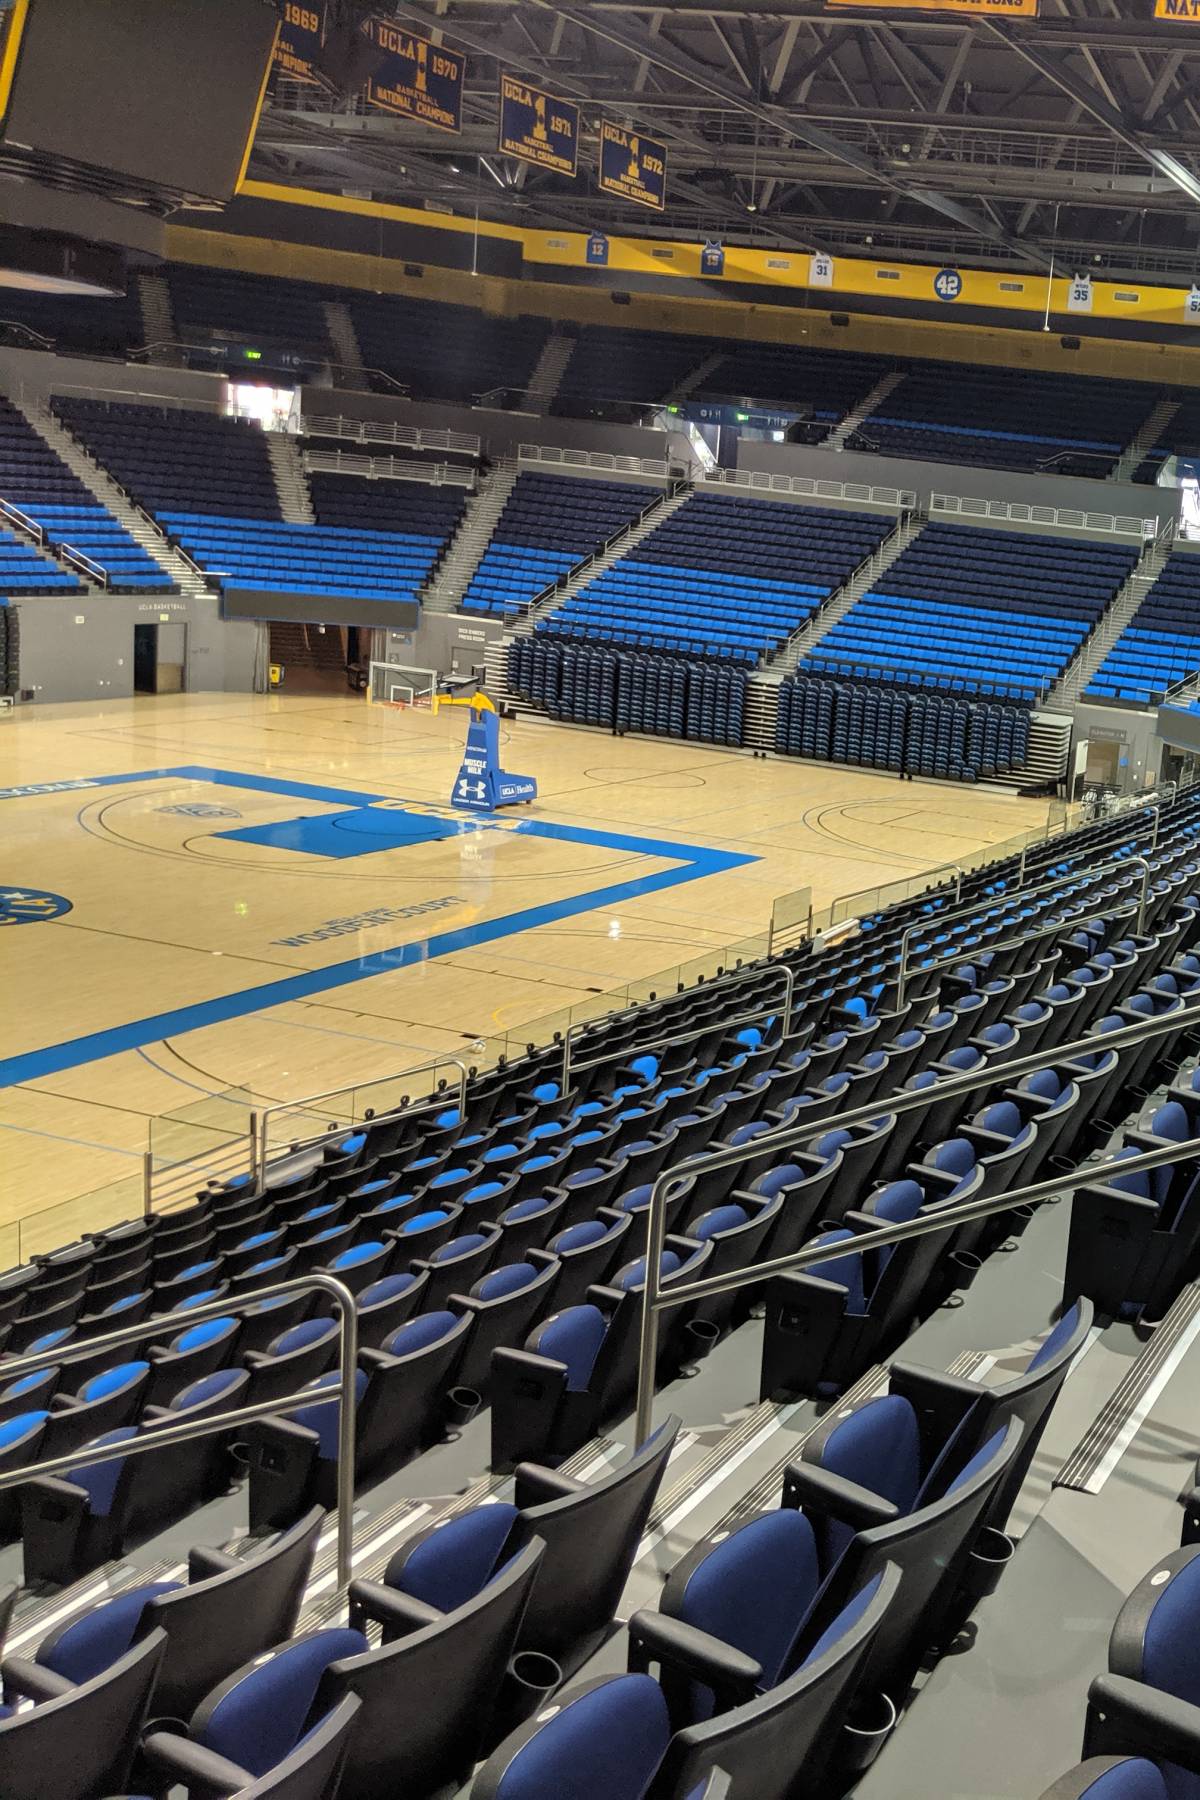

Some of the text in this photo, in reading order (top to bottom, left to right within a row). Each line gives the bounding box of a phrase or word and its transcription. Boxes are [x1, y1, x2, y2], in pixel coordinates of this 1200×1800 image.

[284, 3, 319, 33] 1969
[378, 26, 416, 60] UCLA
[432, 55, 457, 81] 1970
[504, 82, 532, 107] UCLA
[377, 86, 455, 126] NATIONAL CHAMPIONS
[551, 115, 572, 138] 1971
[603, 125, 628, 147] UCLA
[642, 154, 664, 175] 1972
[815, 264, 828, 276] 31
[936, 275, 958, 295] 42
[1073, 289, 1089, 301] 35
[464, 758, 488, 769] MUSCLE
[502, 783, 534, 796] UCLA Health
[269, 895, 469, 948] WOODEN COURT
